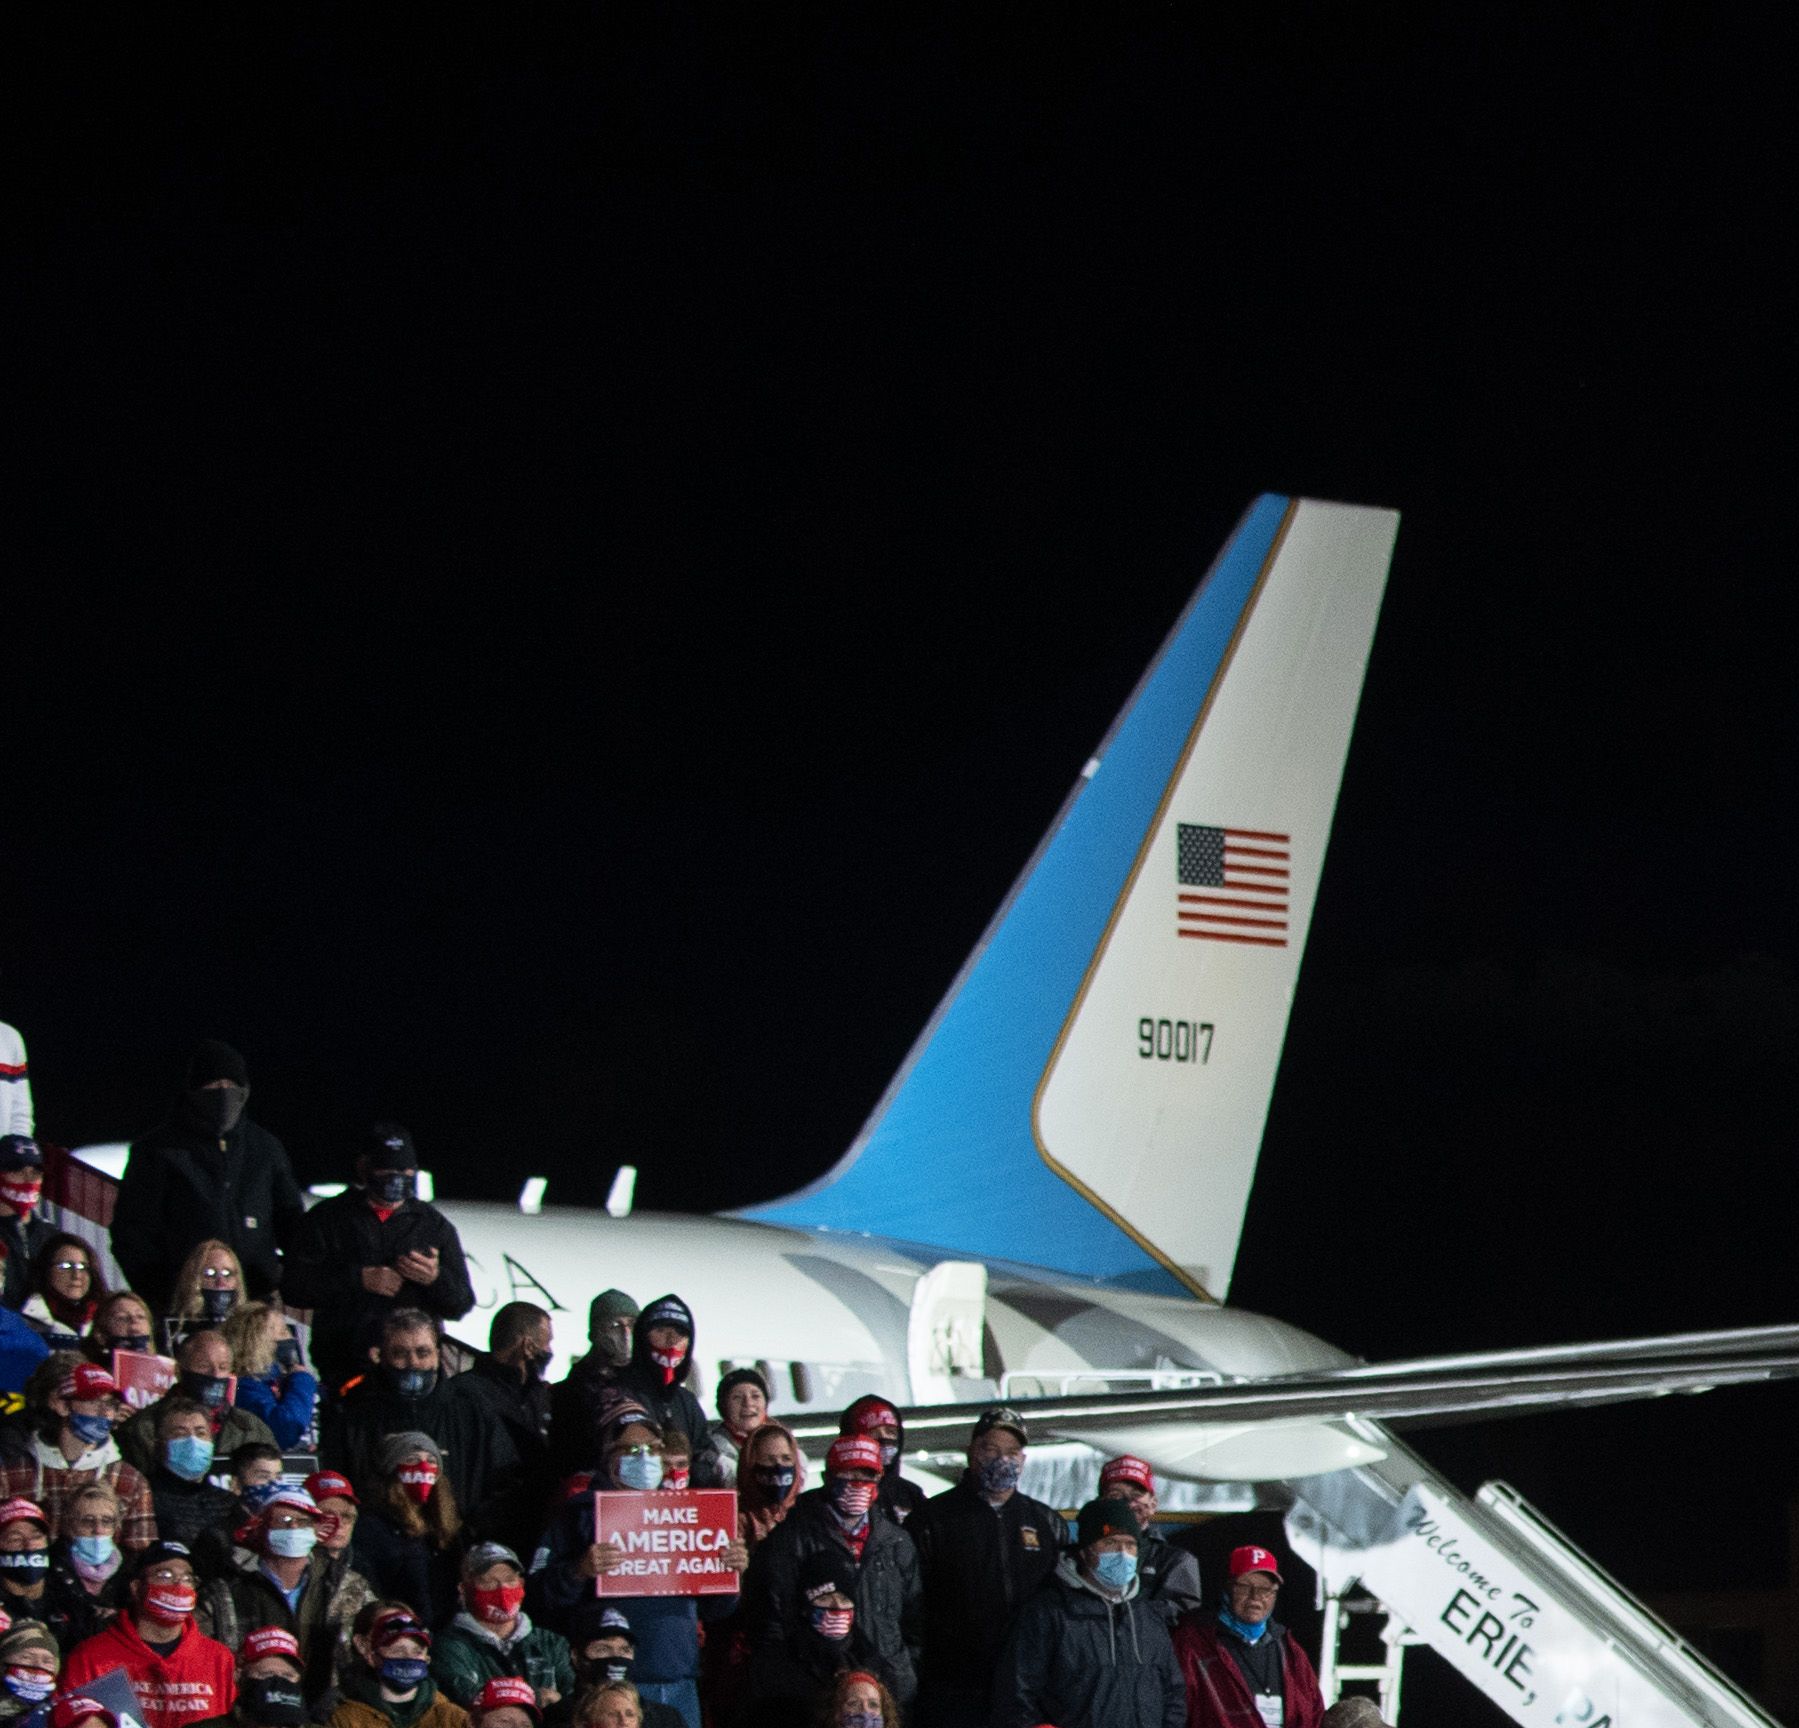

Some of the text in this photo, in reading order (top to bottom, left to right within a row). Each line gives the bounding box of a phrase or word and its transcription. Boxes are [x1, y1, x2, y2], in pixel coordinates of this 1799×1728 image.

[1138, 1017, 1214, 1064] 90017
[400, 1471, 438, 1485] MAG
[643, 1508, 698, 1525] MAKE
[608, 1529, 731, 1554] AMERICA
[676, 1558, 733, 1575] AGAI
[1252, 1549, 1266, 1564] P
[1406, 1504, 1540, 1629] Welcome To
[1440, 1588, 1537, 1706] ERIE,
